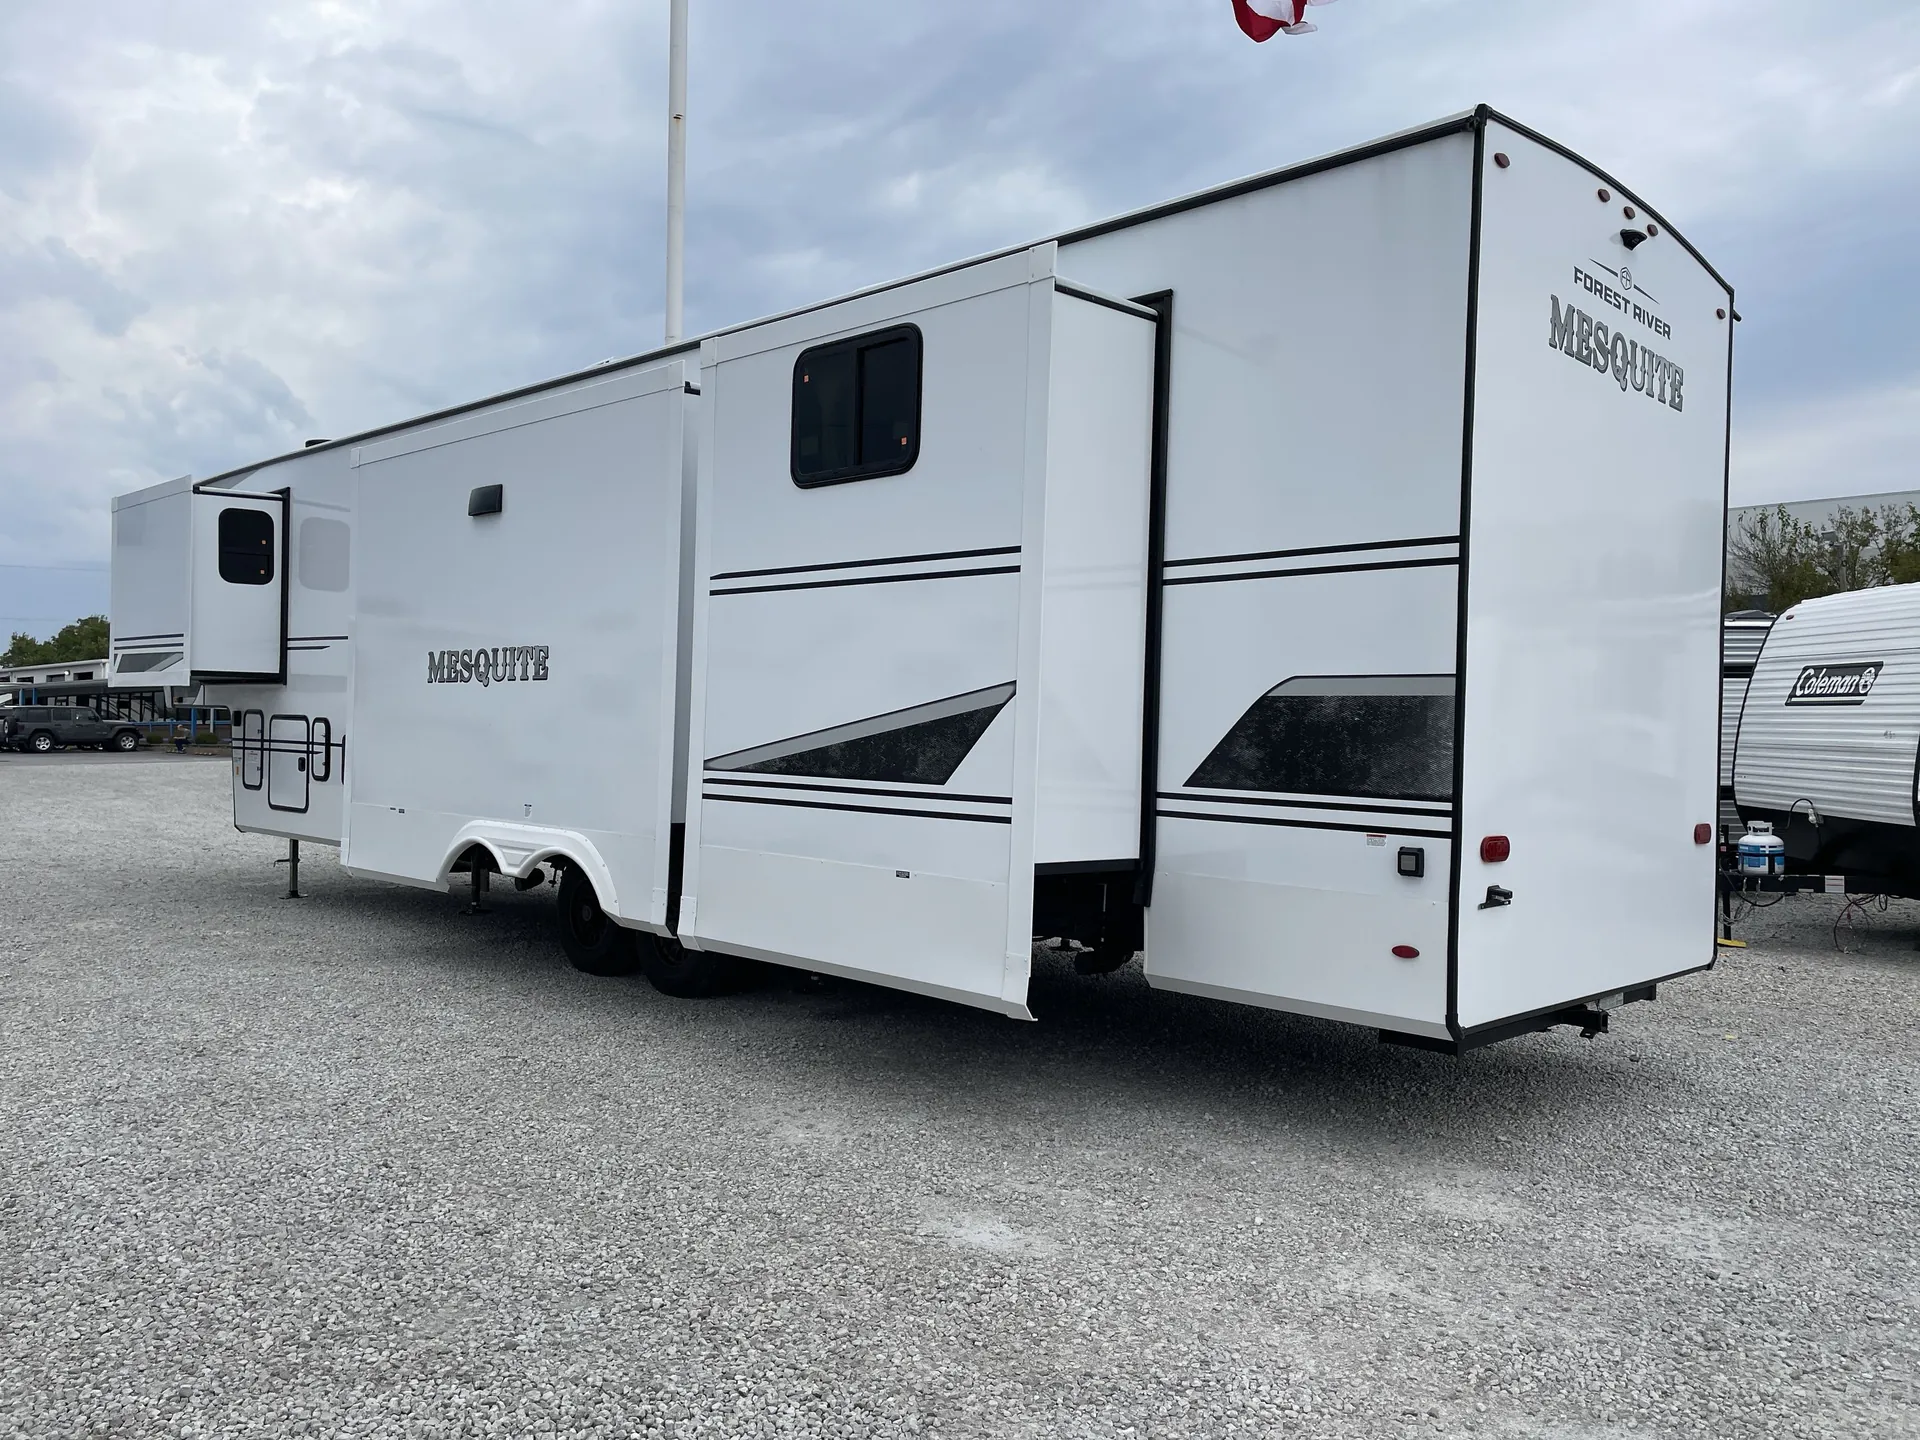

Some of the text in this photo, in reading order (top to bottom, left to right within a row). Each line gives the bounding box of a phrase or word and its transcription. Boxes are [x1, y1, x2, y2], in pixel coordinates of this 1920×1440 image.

[1573, 266, 1671, 340] FOREST RIVER
[1549, 294, 1684, 412] MESQUITE
[427, 645, 549, 687] MESQUITE
[1795, 668, 1860, 696] Coleman
